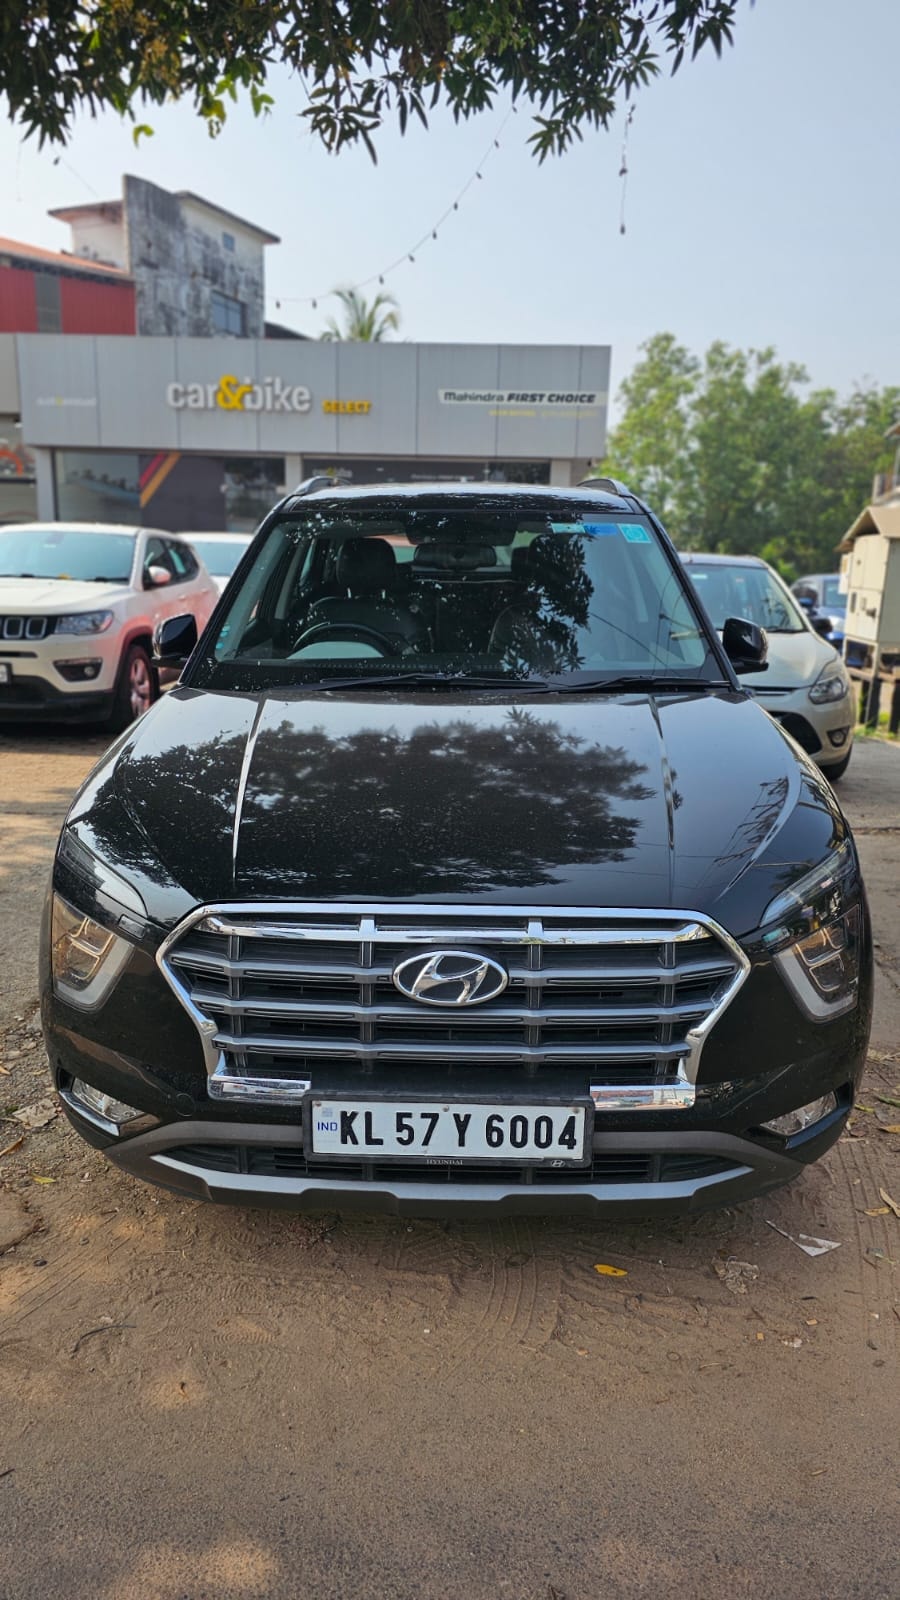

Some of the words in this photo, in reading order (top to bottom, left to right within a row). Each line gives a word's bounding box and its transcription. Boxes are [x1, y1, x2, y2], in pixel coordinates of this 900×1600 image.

[166, 374, 312, 412] car&bike
[443, 391, 505, 403] Mahindra
[506, 392, 546, 403] FIRST
[546, 393, 597, 404] CHOICE
[322, 400, 371, 415] SELECT
[317, 1120, 338, 1132] IND
[340, 1110, 384, 1146] KL
[395, 1111, 440, 1147] 57
[452, 1112, 472, 1148] Y
[485, 1114, 577, 1150] 6004
[425, 1158, 464, 1166] HYUNDAI
